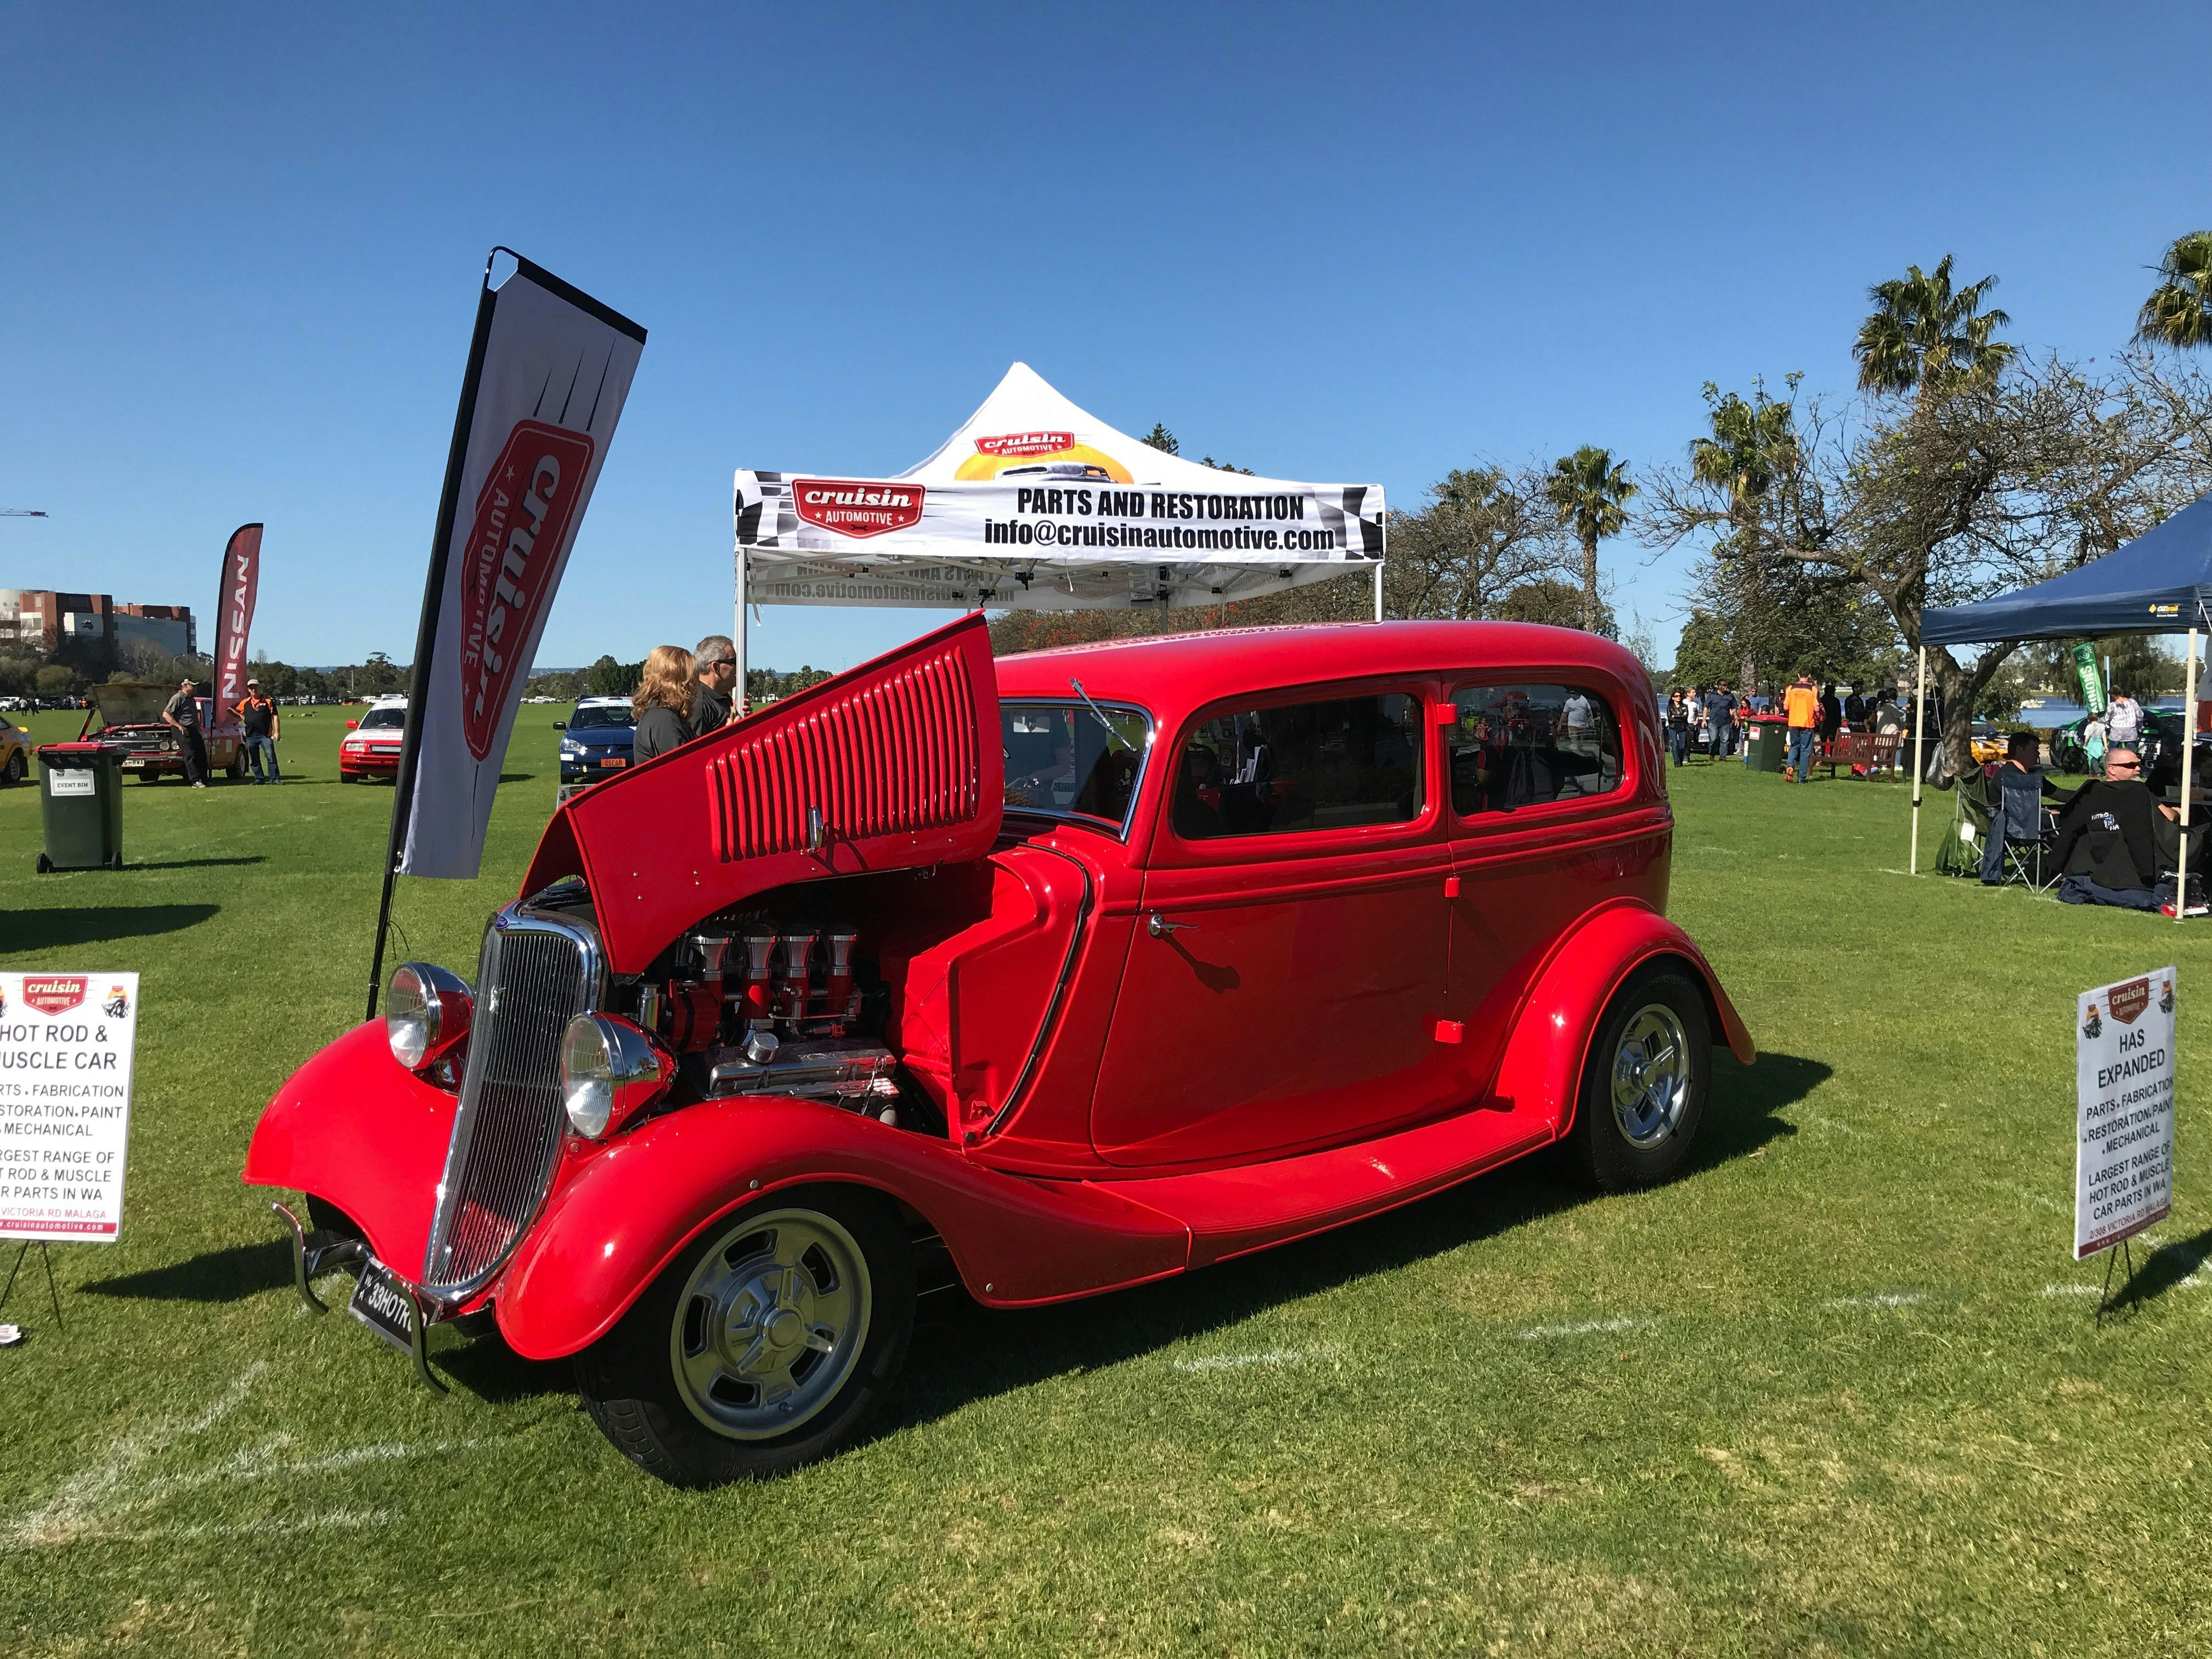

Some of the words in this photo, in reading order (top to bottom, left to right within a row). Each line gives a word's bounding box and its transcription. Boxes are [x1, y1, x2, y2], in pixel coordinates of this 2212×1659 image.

[984, 434, 1066, 448] cruisin
[1002, 444, 1053, 455] AUTOMOTIVE
[805, 488, 913, 507] cruisin
[1018, 488, 1092, 516] PARTS
[1097, 490, 1144, 517] AND
[1152, 493, 1304, 520] RESTORATION
[826, 510, 893, 526] AUTOMOTIVE
[985, 518, 1334, 550] info@cruisinautomotive.com
[464, 487, 510, 668] AUTOMOTIVE
[473, 454, 560, 724] cruisin
[223, 554, 249, 698] NISSAN
[27, 980, 82, 994] cruisin
[2112, 985, 2145, 1006] cruisin
[36, 997, 71, 1006] AUTOMOTIVE
[0, 1024, 40, 1042] HOT
[46, 1024, 88, 1042] ROD
[95, 1024, 108, 1042] &
[2120, 1029, 2145, 1053] HAS
[0, 1051, 68, 1069] USCLE
[75, 1052, 117, 1070] CAR
[2098, 1048, 2165, 1088] EXPANDED
[32, 1085, 124, 1097] FABRICATION
[2087, 1099, 2115, 1120] PARTS
[2121, 1076, 2173, 1107] FABRICATION
[82, 1106, 123, 1119] PAINT
[4, 1122, 93, 1136] MECHANICAL
[2106, 1121, 2160, 1153] MECHANICAL
[43, 1150, 92, 1164] RANGE
[96, 1152, 115, 1164] OF
[2089, 1159, 2129, 1186] LARGEST
[2131, 1147, 2159, 1169] RANGE
[2162, 1140, 2170, 1156] OF
[8, 1168, 37, 1181] ROD
[41, 1169, 49, 1181] &
[54, 1170, 112, 1182] MUSCLE
[2090, 1186, 2109, 1204] HOT
[2111, 1178, 2129, 1196] ROD
[2131, 1175, 2137, 1187] &
[2140, 1158, 2170, 1183] MUSCLE
[14, 1186, 58, 1200] PARTS
[63, 1187, 76, 1200] IN
[81, 1188, 103, 1200] WA
[2094, 1202, 2113, 1220] CAR
[2115, 1189, 2142, 1211] PARTS
[2145, 1184, 2151, 1198] IN
[2153, 1178, 2165, 1193] WA
[2, 1207, 44, 1217] VICTORIA
[48, 1209, 61, 1218] RD
[65, 1209, 106, 1219] MALAGA
